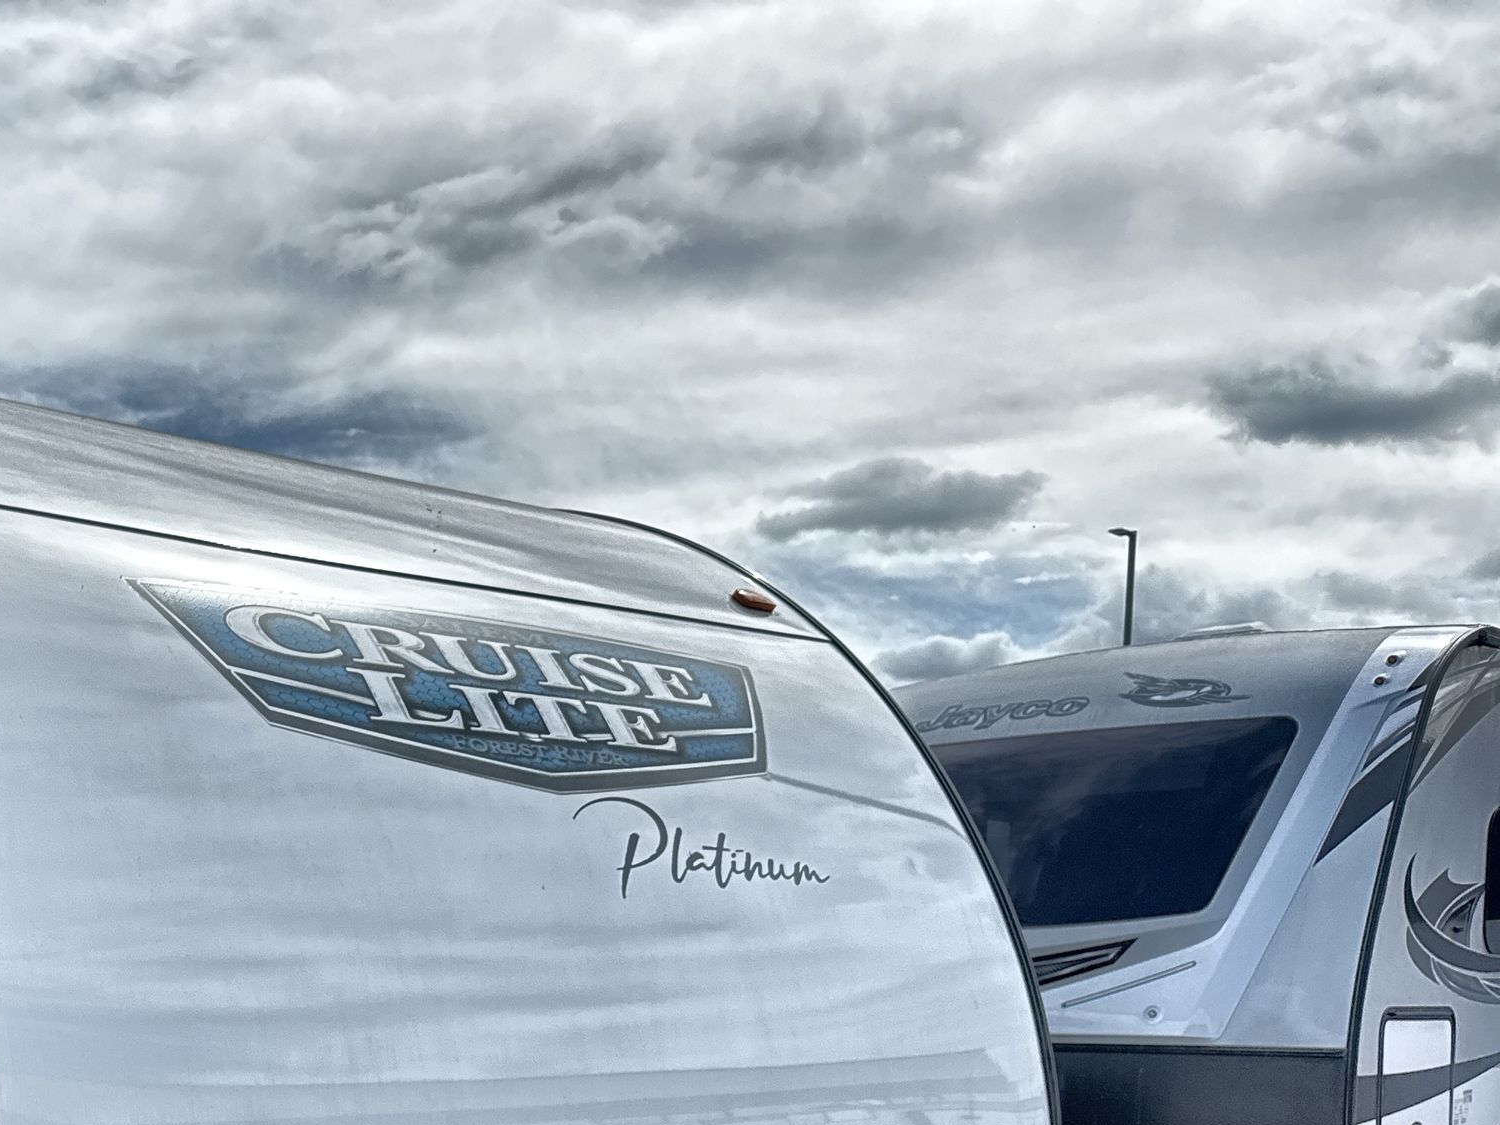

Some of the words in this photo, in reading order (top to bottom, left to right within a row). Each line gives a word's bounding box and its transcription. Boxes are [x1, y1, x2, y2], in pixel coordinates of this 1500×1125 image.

[223, 603, 714, 708] CRUISE
[346, 665, 678, 753] LITE
[452, 733, 548, 759] FOREST
[556, 744, 631, 767] RIVER
[915, 696, 1090, 733] Jayco
[572, 796, 831, 899] Platinum
